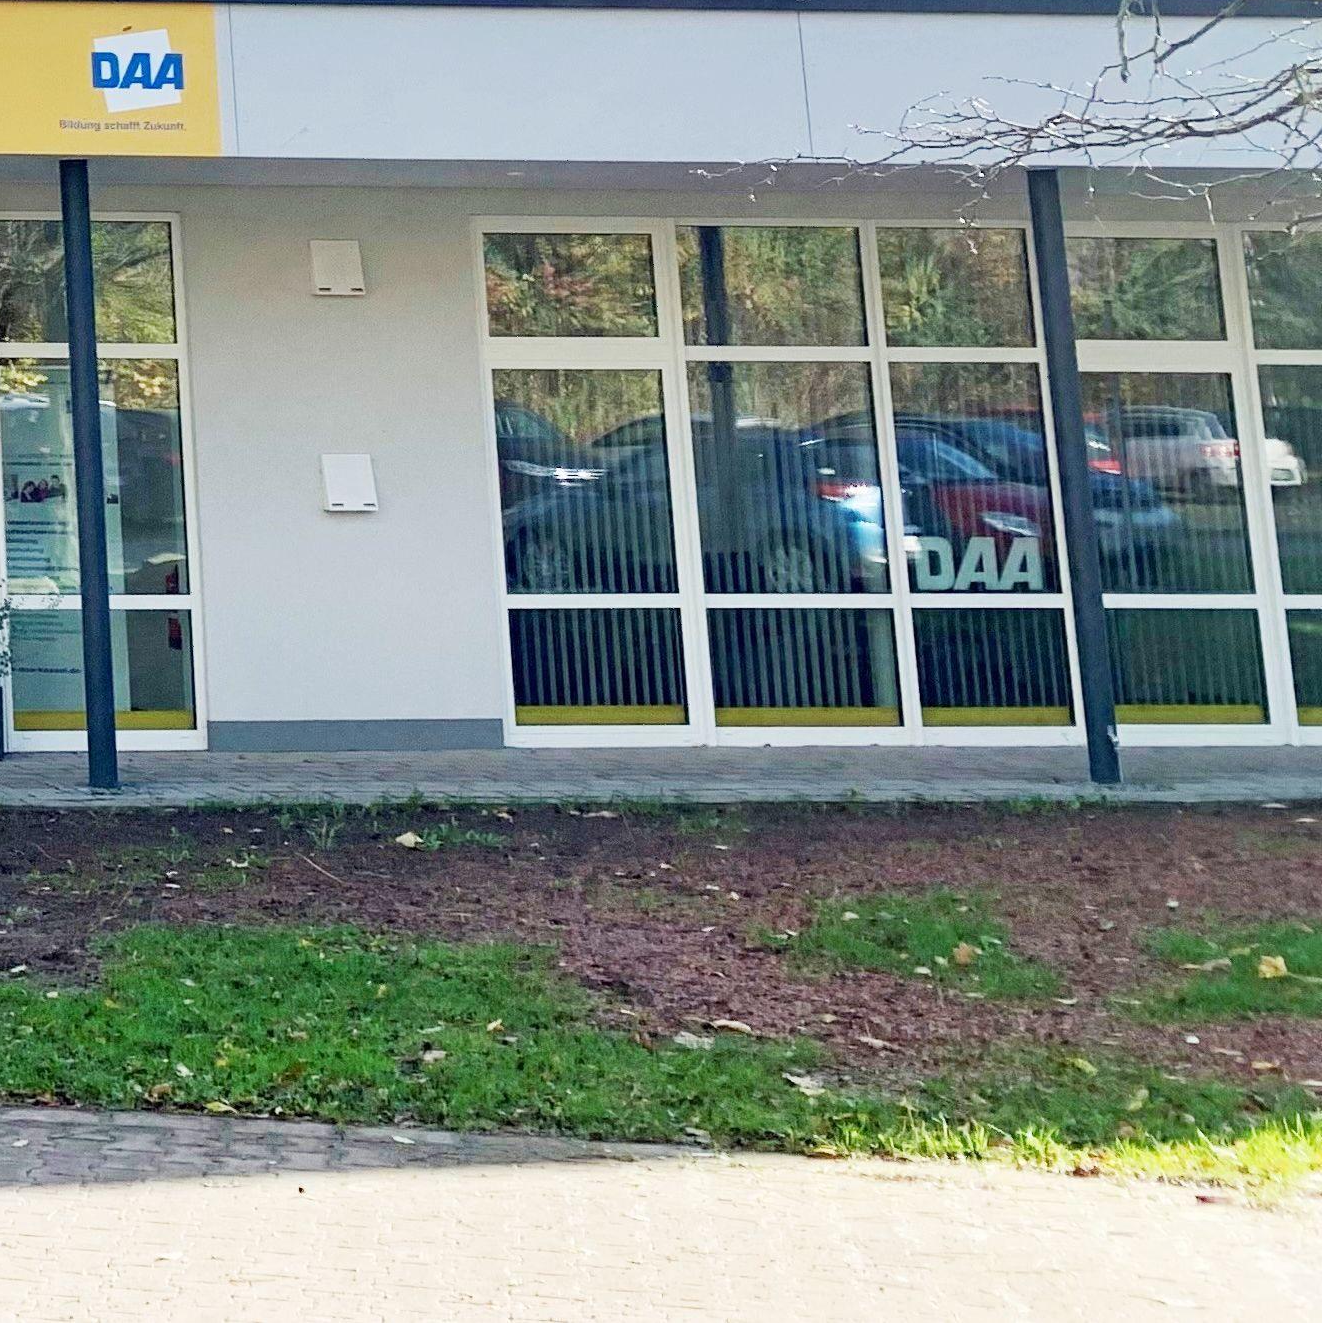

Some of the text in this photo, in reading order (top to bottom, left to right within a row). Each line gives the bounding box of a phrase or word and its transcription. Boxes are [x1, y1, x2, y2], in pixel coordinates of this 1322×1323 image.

[91, 52, 184, 90] DAA
[59, 119, 101, 132] Bildung
[104, 121, 140, 131] schafft
[915, 536, 1044, 591] DAA
